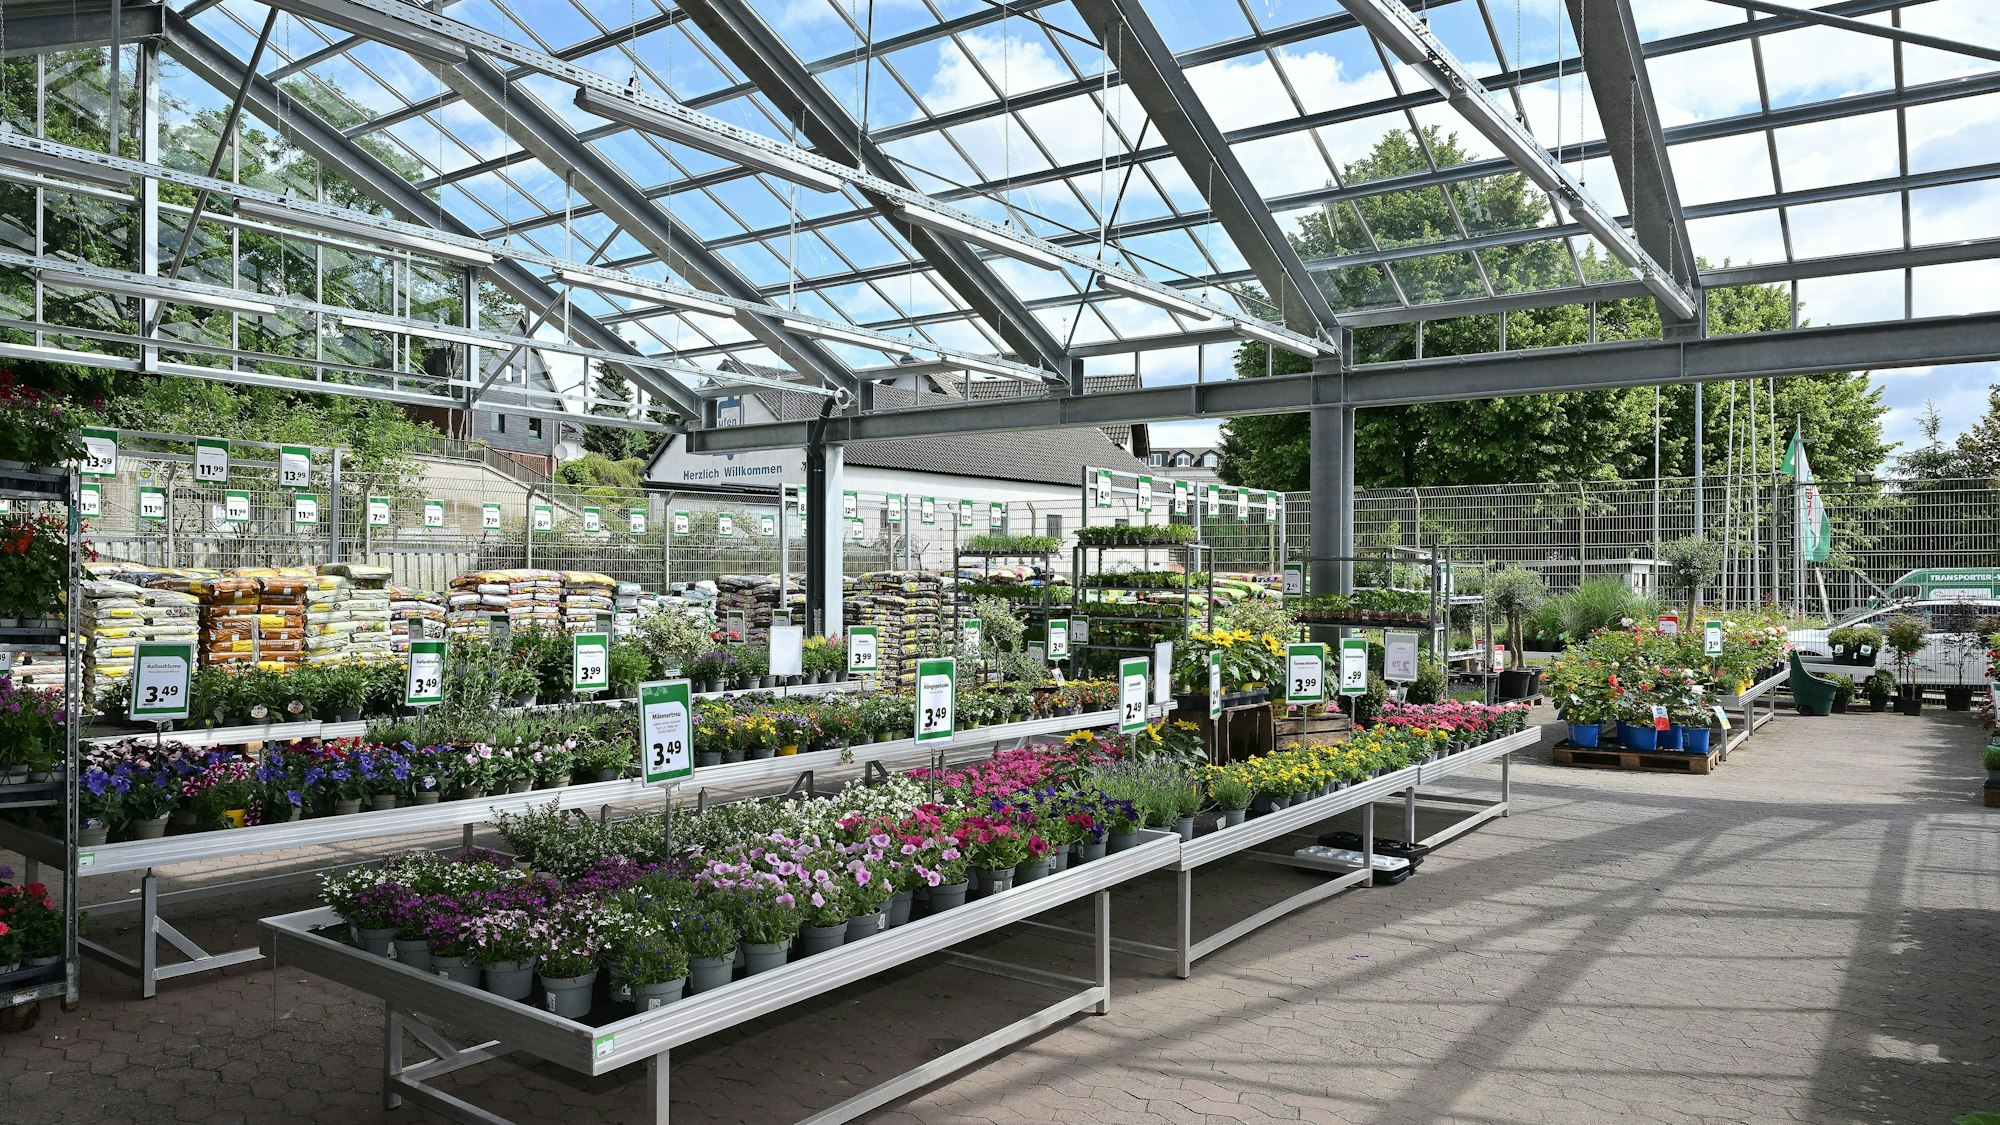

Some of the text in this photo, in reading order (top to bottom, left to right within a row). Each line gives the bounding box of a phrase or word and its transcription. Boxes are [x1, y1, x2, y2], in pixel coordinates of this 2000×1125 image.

[86, 457, 112, 468] 13.49
[199, 464, 224, 476] 11.99
[682, 465, 782, 481] Herzlich Willkommen
[284, 471, 306, 481] 13.99
[143, 505, 162, 514] 11.99
[229, 508, 246, 517] 11.99
[298, 511, 314, 519] 11.99
[372, 513, 386, 522] 7.49
[427, 515, 440, 524] 7.49
[485, 517, 498, 525] 7.99
[854, 653, 872, 664] 3.99
[581, 666, 601, 680] 3.99
[415, 678, 437, 693] 3.49
[1294, 678, 1317, 692] 3.99
[145, 685, 179, 703] 3.49
[652, 711, 681, 720] Männertreu
[1125, 701, 1142, 720] 2.49
[924, 706, 947, 728] 3.49
[653, 740, 682, 766] 3.49
